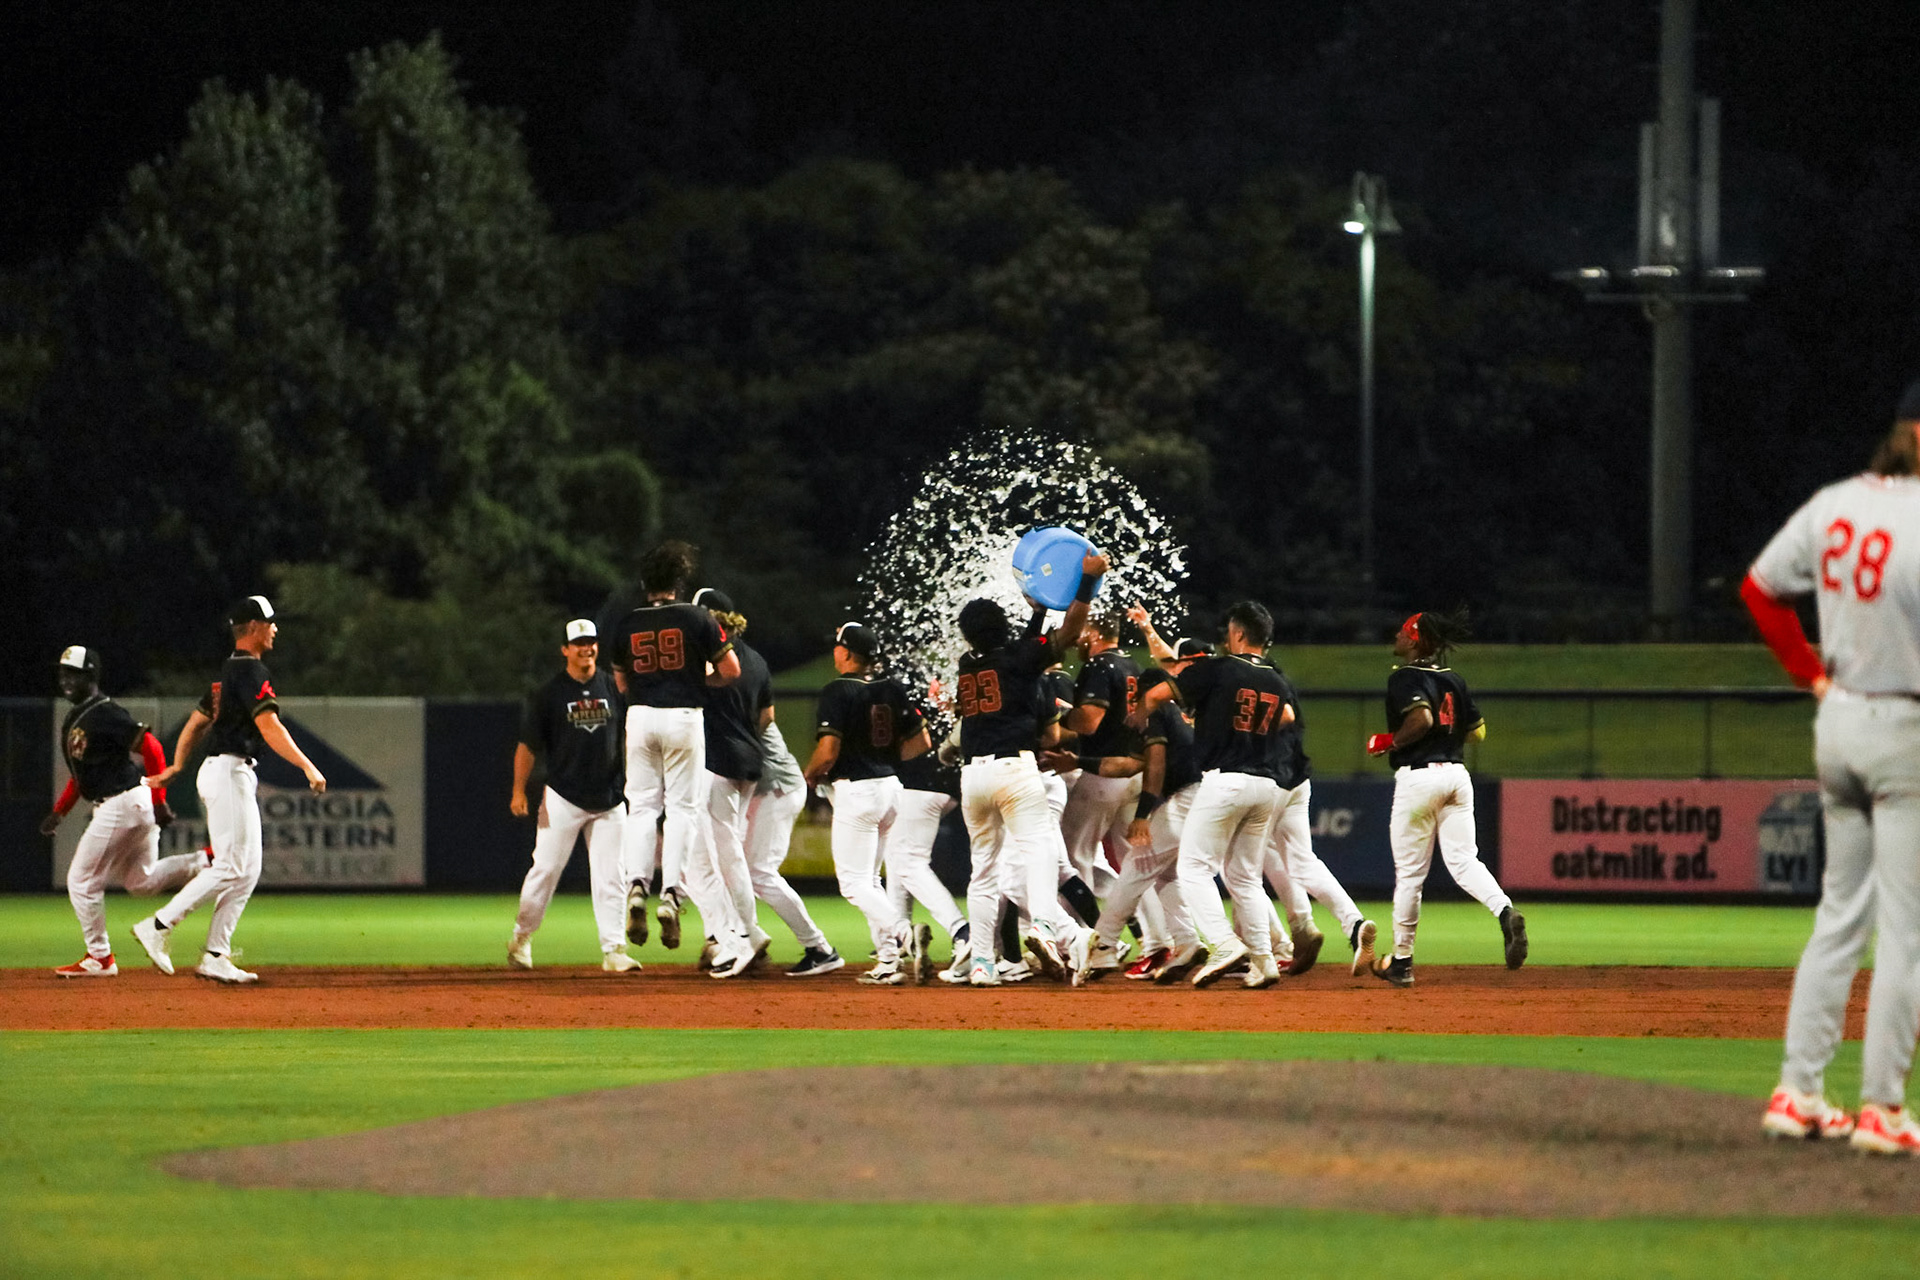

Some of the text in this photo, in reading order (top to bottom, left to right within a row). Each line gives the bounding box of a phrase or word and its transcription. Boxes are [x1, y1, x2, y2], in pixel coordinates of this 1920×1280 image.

[1822, 518, 1893, 602] 28
[630, 628, 685, 674] 59
[958, 669, 1002, 717] 23
[1233, 687, 1280, 735] 37
[1439, 692, 1454, 735] 4
[870, 703, 892, 747] 8
[263, 794, 395, 820] ORGIA
[1551, 796, 1722, 842] Distracting
[1552, 844, 1717, 881] oatmilk ad.
